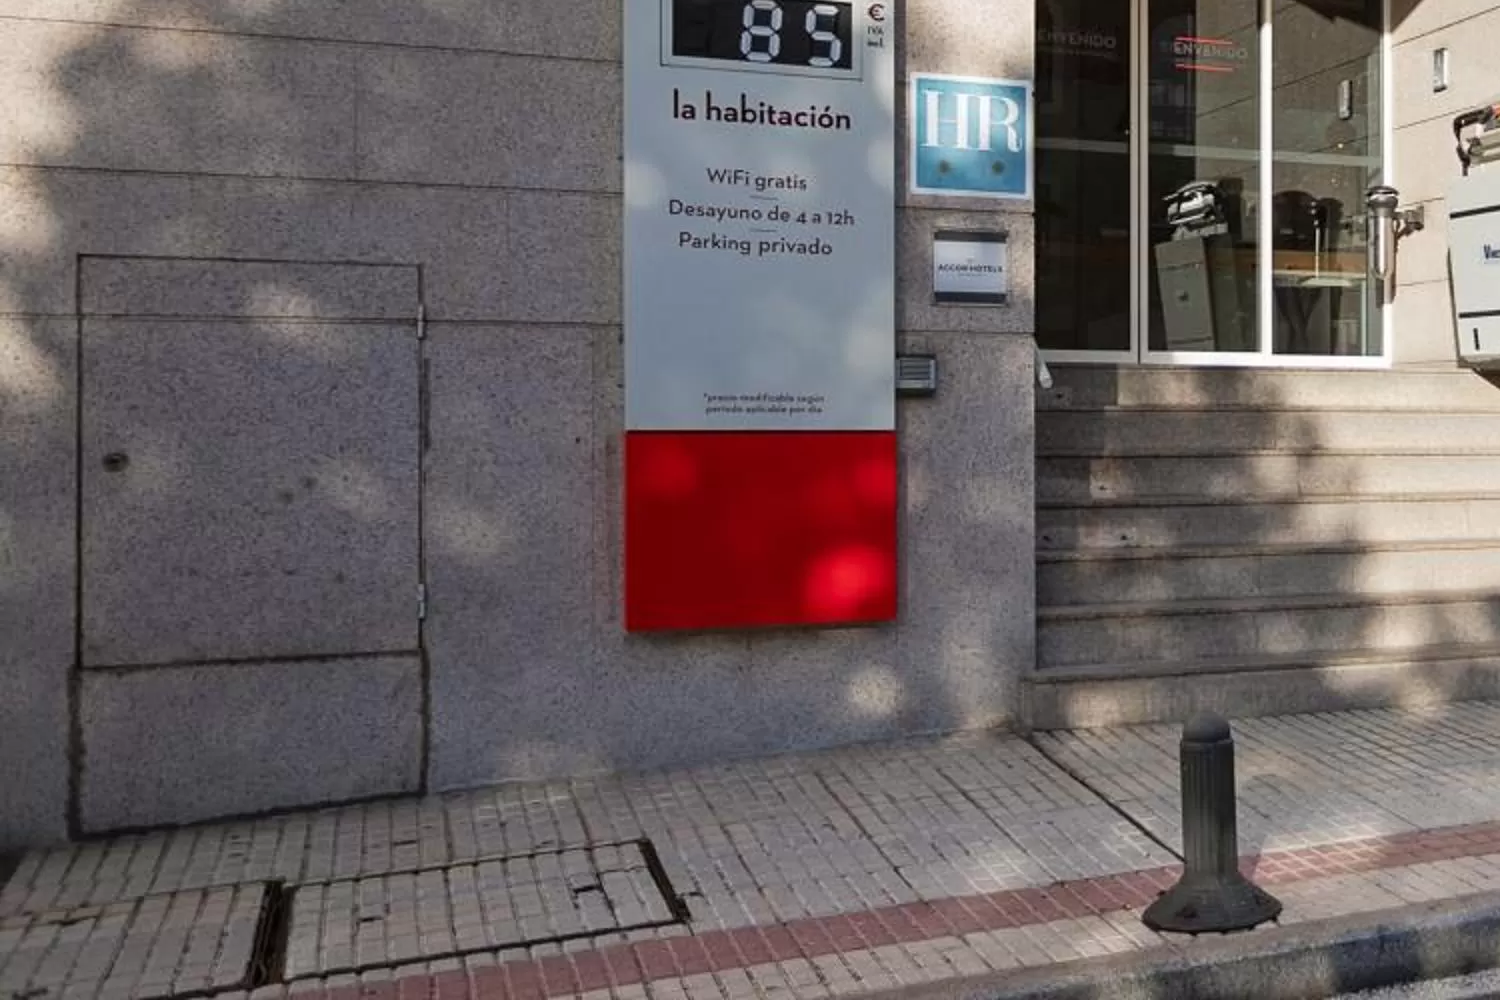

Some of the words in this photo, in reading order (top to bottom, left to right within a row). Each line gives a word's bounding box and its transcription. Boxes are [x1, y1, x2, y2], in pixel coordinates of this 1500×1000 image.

[740, 0, 842, 67] 85
[672, 88, 696, 119] la
[705, 90, 851, 130] habitación
[920, 90, 1023, 152] HR
[706, 167, 750, 186] WiFi
[754, 174, 807, 191] gratis
[668, 199, 763, 222] Desayuno
[767, 205, 791, 222] de
[795, 212, 807, 225] 4
[811, 213, 822, 225] a
[827, 209, 856, 227] 12h
[678, 231, 751, 256] Parking
[758, 237, 833, 257] privado
